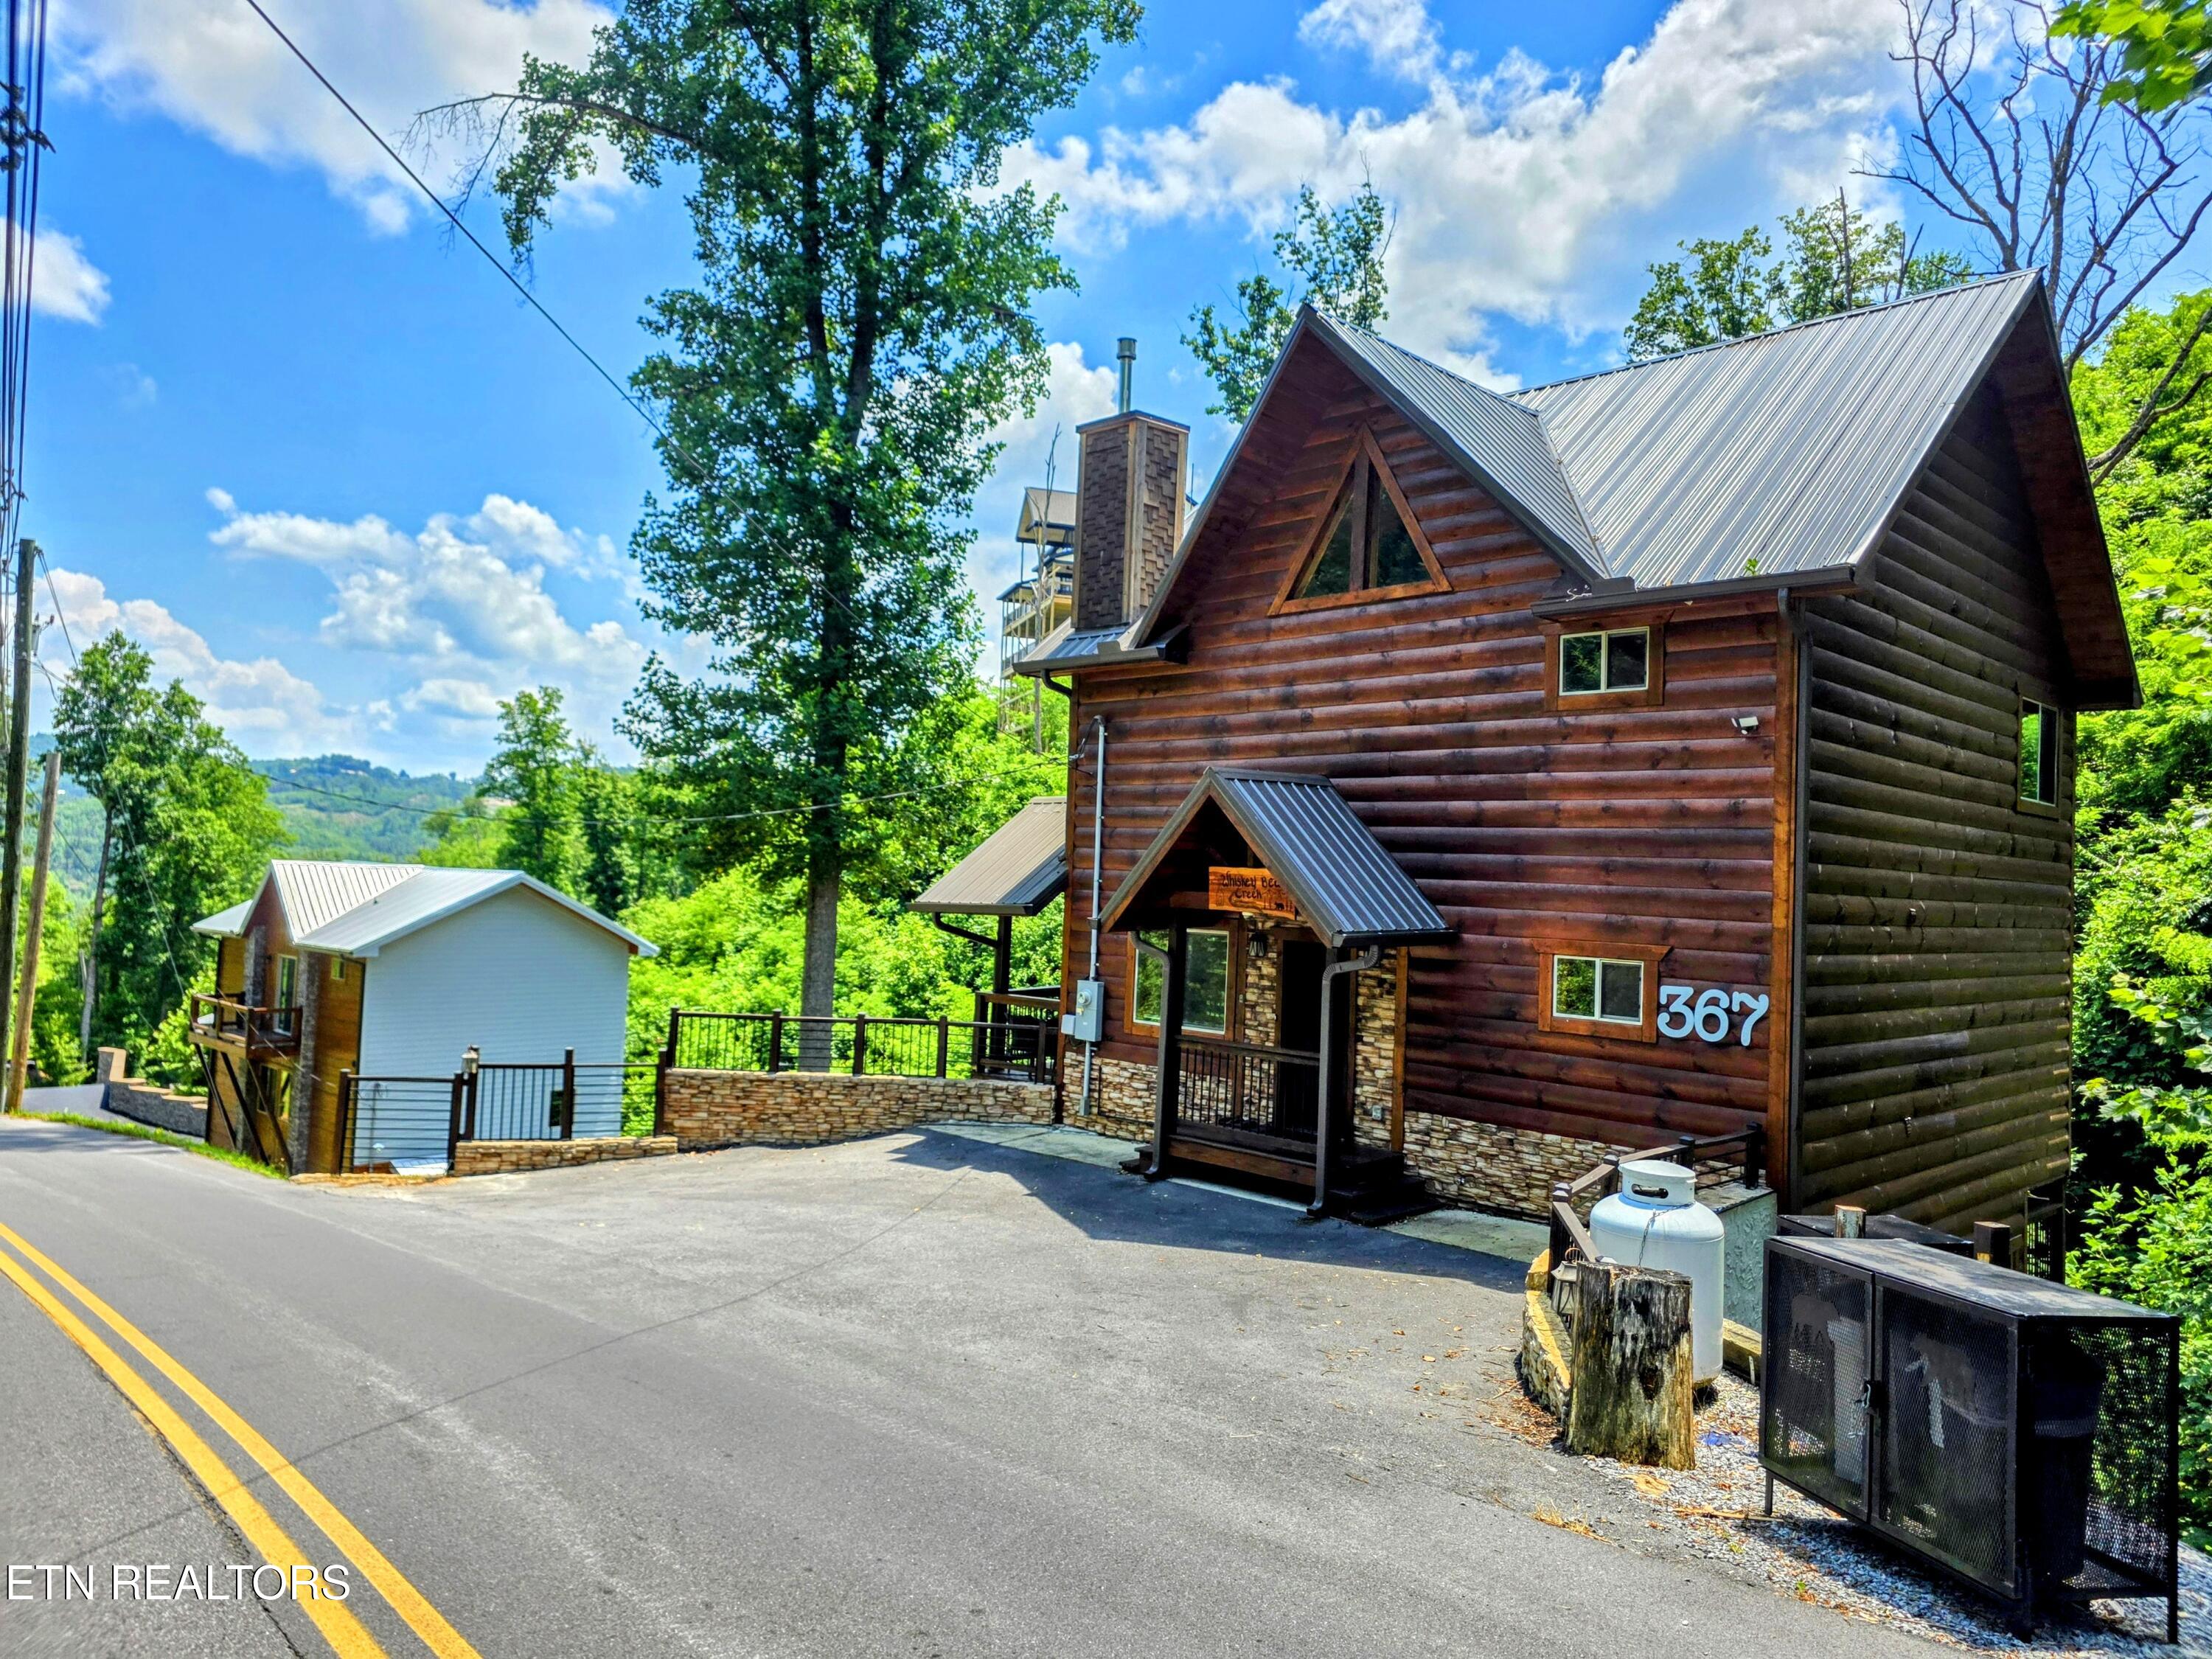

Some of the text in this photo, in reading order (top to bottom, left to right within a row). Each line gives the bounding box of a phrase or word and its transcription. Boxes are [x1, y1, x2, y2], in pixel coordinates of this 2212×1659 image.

[1221, 871, 1256, 889] Whiskey
[1234, 888, 1262, 900] Creek
[1657, 985, 1770, 1046] 367
